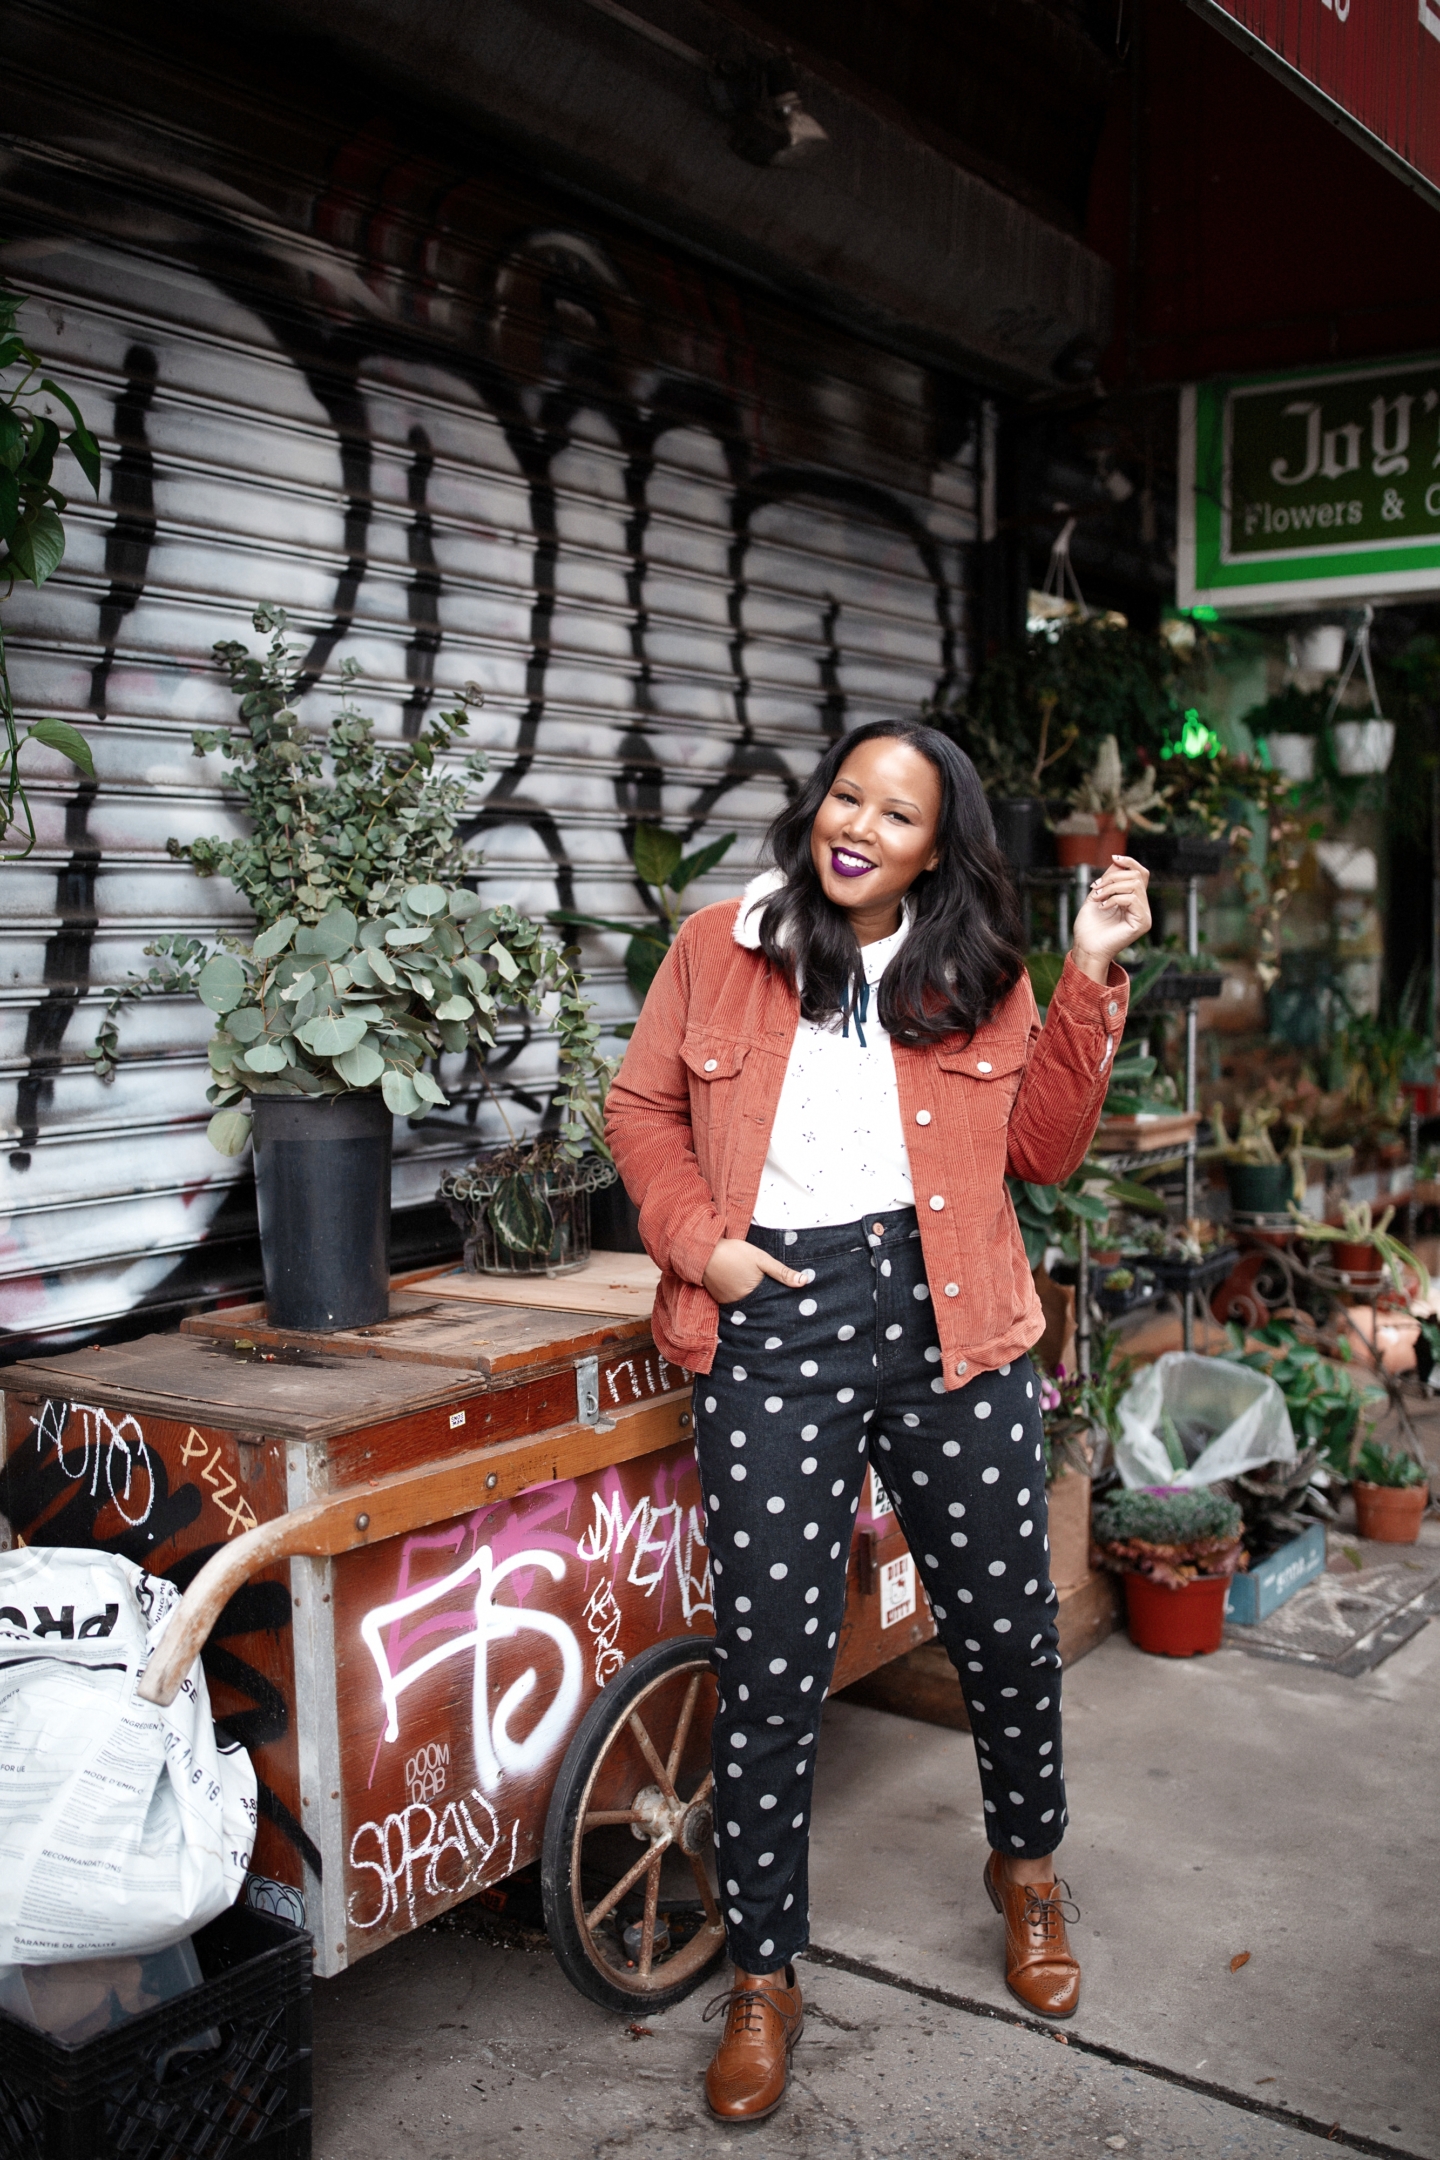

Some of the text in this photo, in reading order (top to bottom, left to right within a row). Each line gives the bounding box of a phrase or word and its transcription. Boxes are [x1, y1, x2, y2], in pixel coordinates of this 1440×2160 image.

[1244, 498, 1364, 535] Flowers
[405, 1743, 450, 1786] DOOM
[411, 1766, 446, 1804] DAB
[41, 1849, 122, 1874] RECOMMANDATIONS
[14, 1935, 60, 1949] GARANTIE
